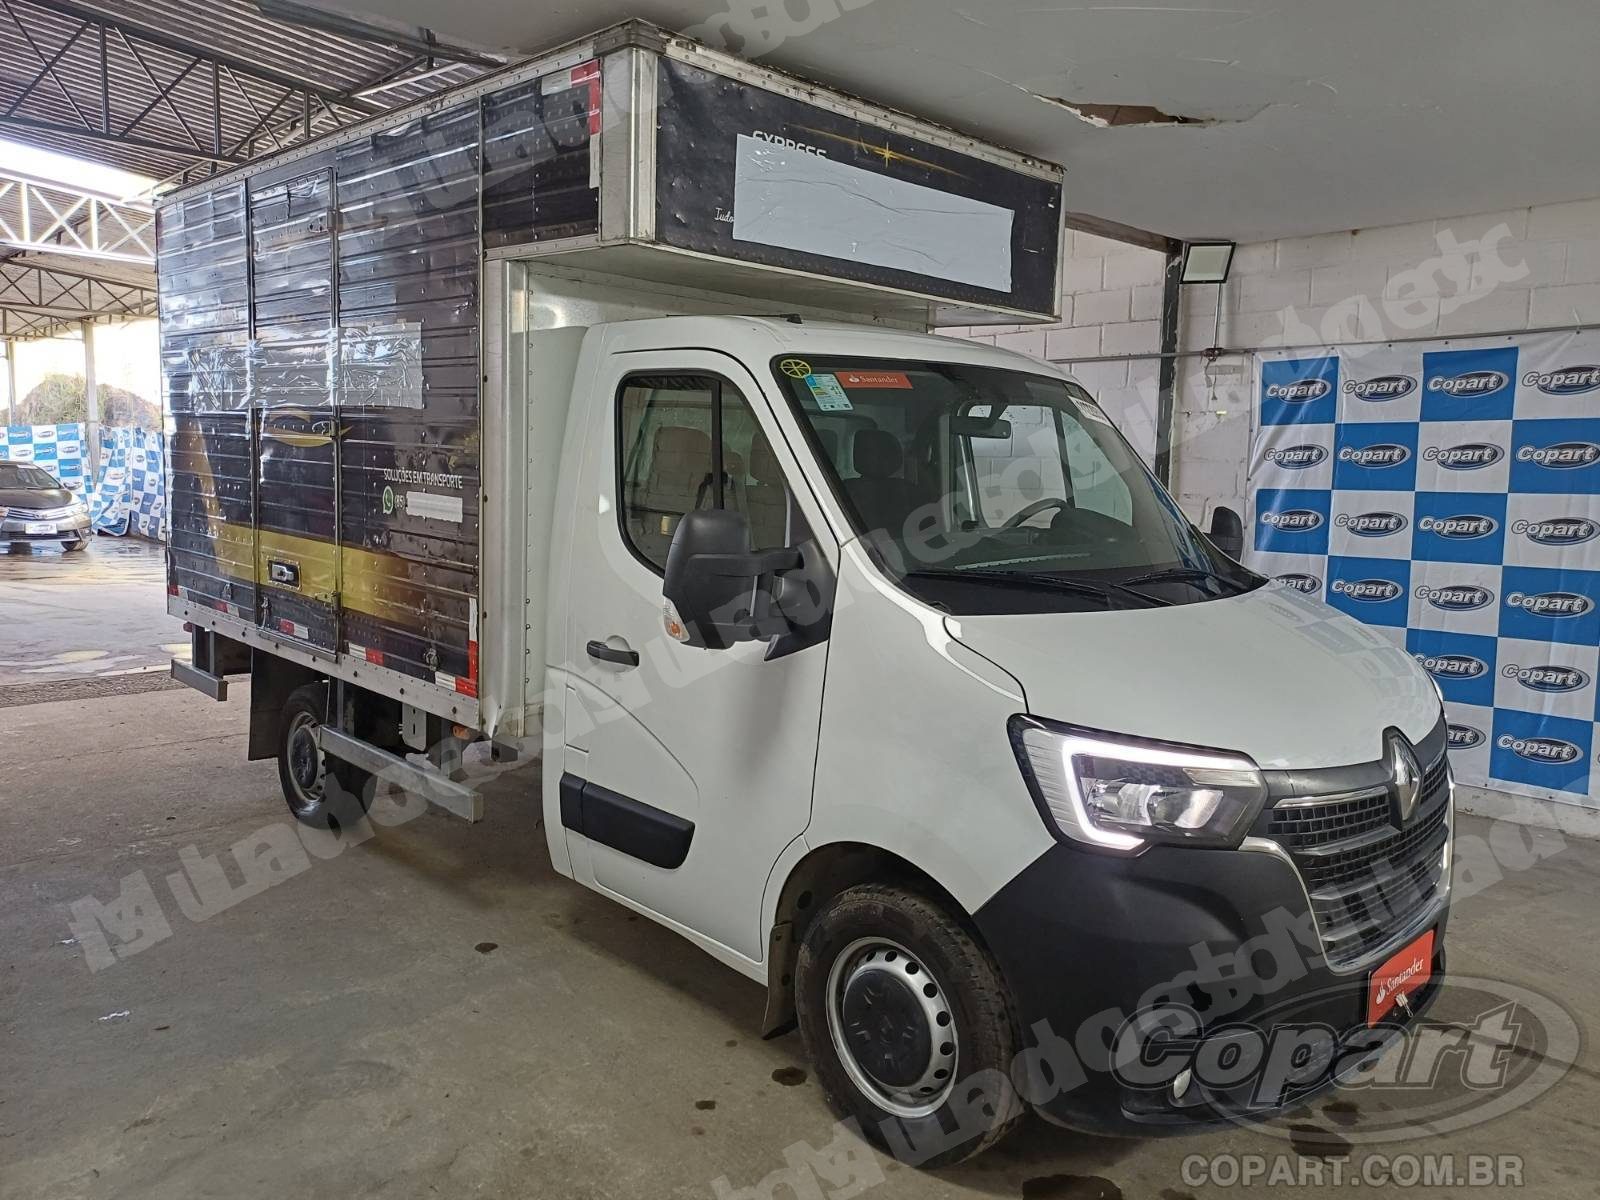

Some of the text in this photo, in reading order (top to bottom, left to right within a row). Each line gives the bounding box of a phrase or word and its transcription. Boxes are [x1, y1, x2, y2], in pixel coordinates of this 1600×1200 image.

[859, 376, 898, 384] Santander
[1342, 379, 1407, 395] Copart
[1428, 374, 1498, 392] Copart
[1522, 368, 1600, 390] Copart
[1266, 381, 1322, 398] Copart
[1264, 448, 1318, 462] Copart
[1339, 446, 1401, 463] Copart
[1423, 446, 1493, 464] Copart
[1516, 445, 1595, 466] Copart
[422, 471, 463, 489] TRANSPORTE
[1261, 512, 1316, 527] Copart
[1335, 513, 1398, 530] Copart
[1419, 515, 1488, 535] Copart
[1511, 519, 1589, 538] Copart
[1331, 579, 1394, 597] Copart
[1415, 585, 1484, 605] Copart
[1506, 592, 1585, 612] Copart
[1502, 663, 1577, 686] Copart
[1497, 734, 1575, 760] Copart
[1386, 957, 1423, 996] Santander
